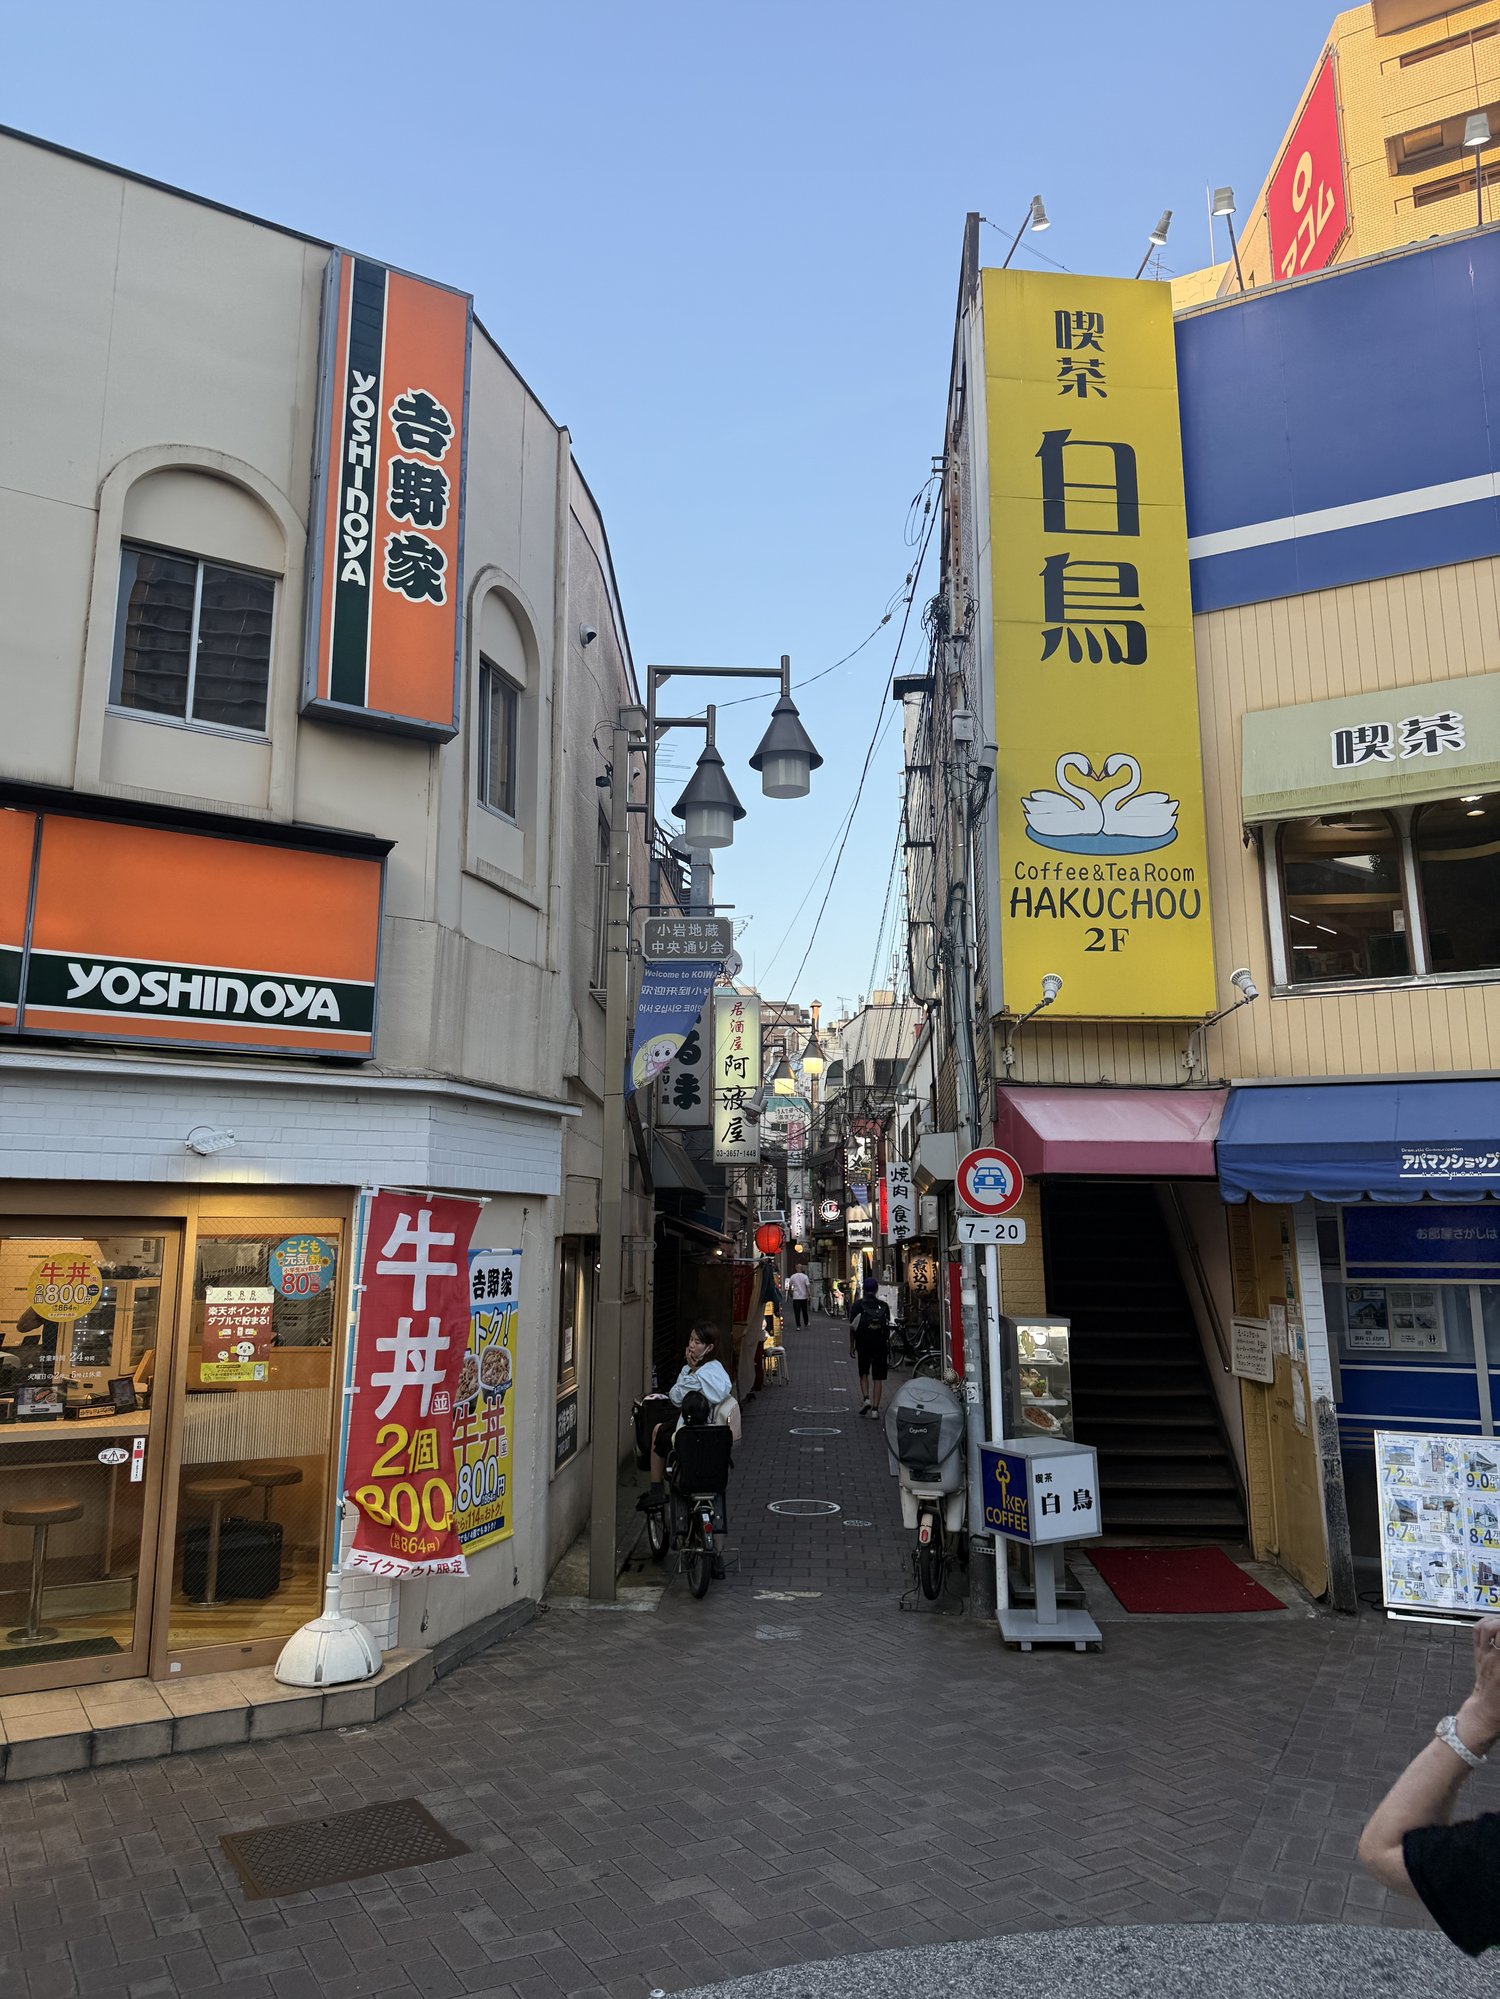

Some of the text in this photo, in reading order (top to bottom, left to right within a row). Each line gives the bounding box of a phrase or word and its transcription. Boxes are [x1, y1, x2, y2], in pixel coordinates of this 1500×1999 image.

[1053, 310, 1107, 399] 喫茶
[341, 370, 376, 587] YOSHINOYA
[385, 388, 456, 607] 吉野家
[1035, 428, 1147, 666] 白鳥
[1331, 710, 1467, 769] 喫茶
[1010, 886, 1201, 920] HAKUCHOU
[657, 923, 719, 937] 小岩地蔵
[1084, 927, 1130, 952] 2F
[651, 940, 725, 954] 中央通り会
[644, 969, 679, 979] Welcome
[681, 970, 690, 979] to
[67, 963, 340, 1022] YOSHINOYA
[653, 1004, 682, 1014] 오십시오
[729, 1002, 744, 1051] 居酒屋
[721, 1055, 750, 1144] 阿波屋
[1402, 1152, 1500, 1170] アパマンショップ
[890, 1166, 911, 1242] 焼肉食堂
[965, 1224, 1018, 1239] 7-20
[286, 1240, 321, 1253] こども
[40, 1262, 91, 1285] 牛丼
[473, 1267, 513, 1300] 吉野家
[208, 1306, 271, 1316] 楽天ポイントが
[208, 1316, 270, 1325] ダブルで貯まる!
[371, 1209, 457, 1420] 牛丼
[453, 1394, 506, 1463] 牛丼
[371, 1423, 438, 1478] 2個
[1035, 1473, 1052, 1484] 喫茶
[1006, 1494, 1027, 1515] KEY
[1041, 1489, 1093, 1516] 白鳥
[986, 1506, 1028, 1532] COFFEE
[353, 1554, 465, 1579] テイクアウト限定
